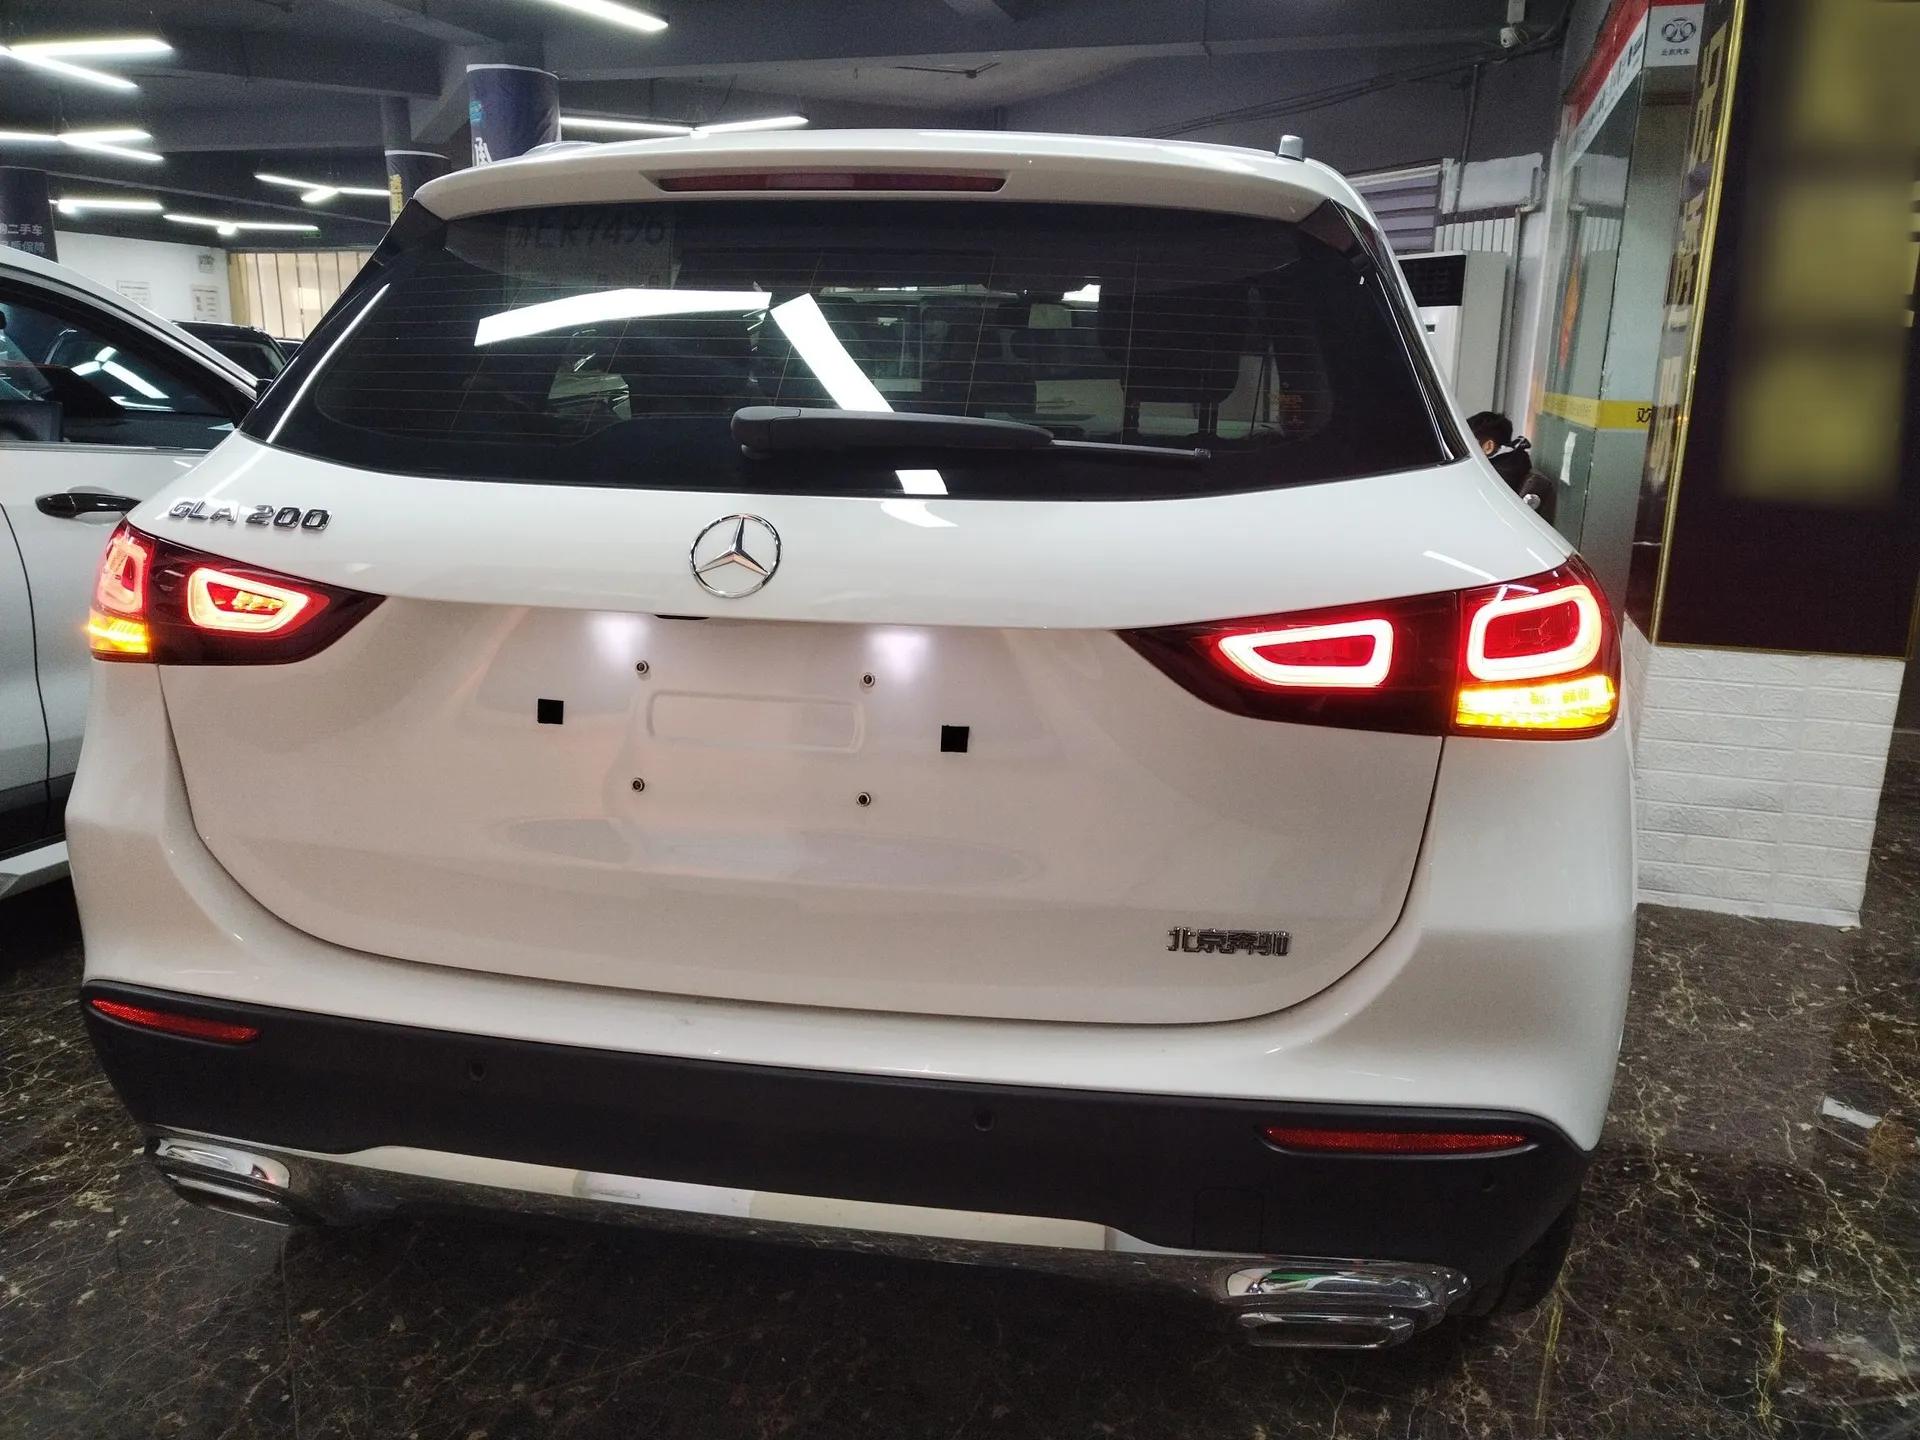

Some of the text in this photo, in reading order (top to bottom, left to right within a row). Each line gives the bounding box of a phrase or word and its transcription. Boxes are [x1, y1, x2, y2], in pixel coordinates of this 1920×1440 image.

[168, 500, 331, 531] GLA 200
[1167, 927, 1292, 956] 北京奔驰
